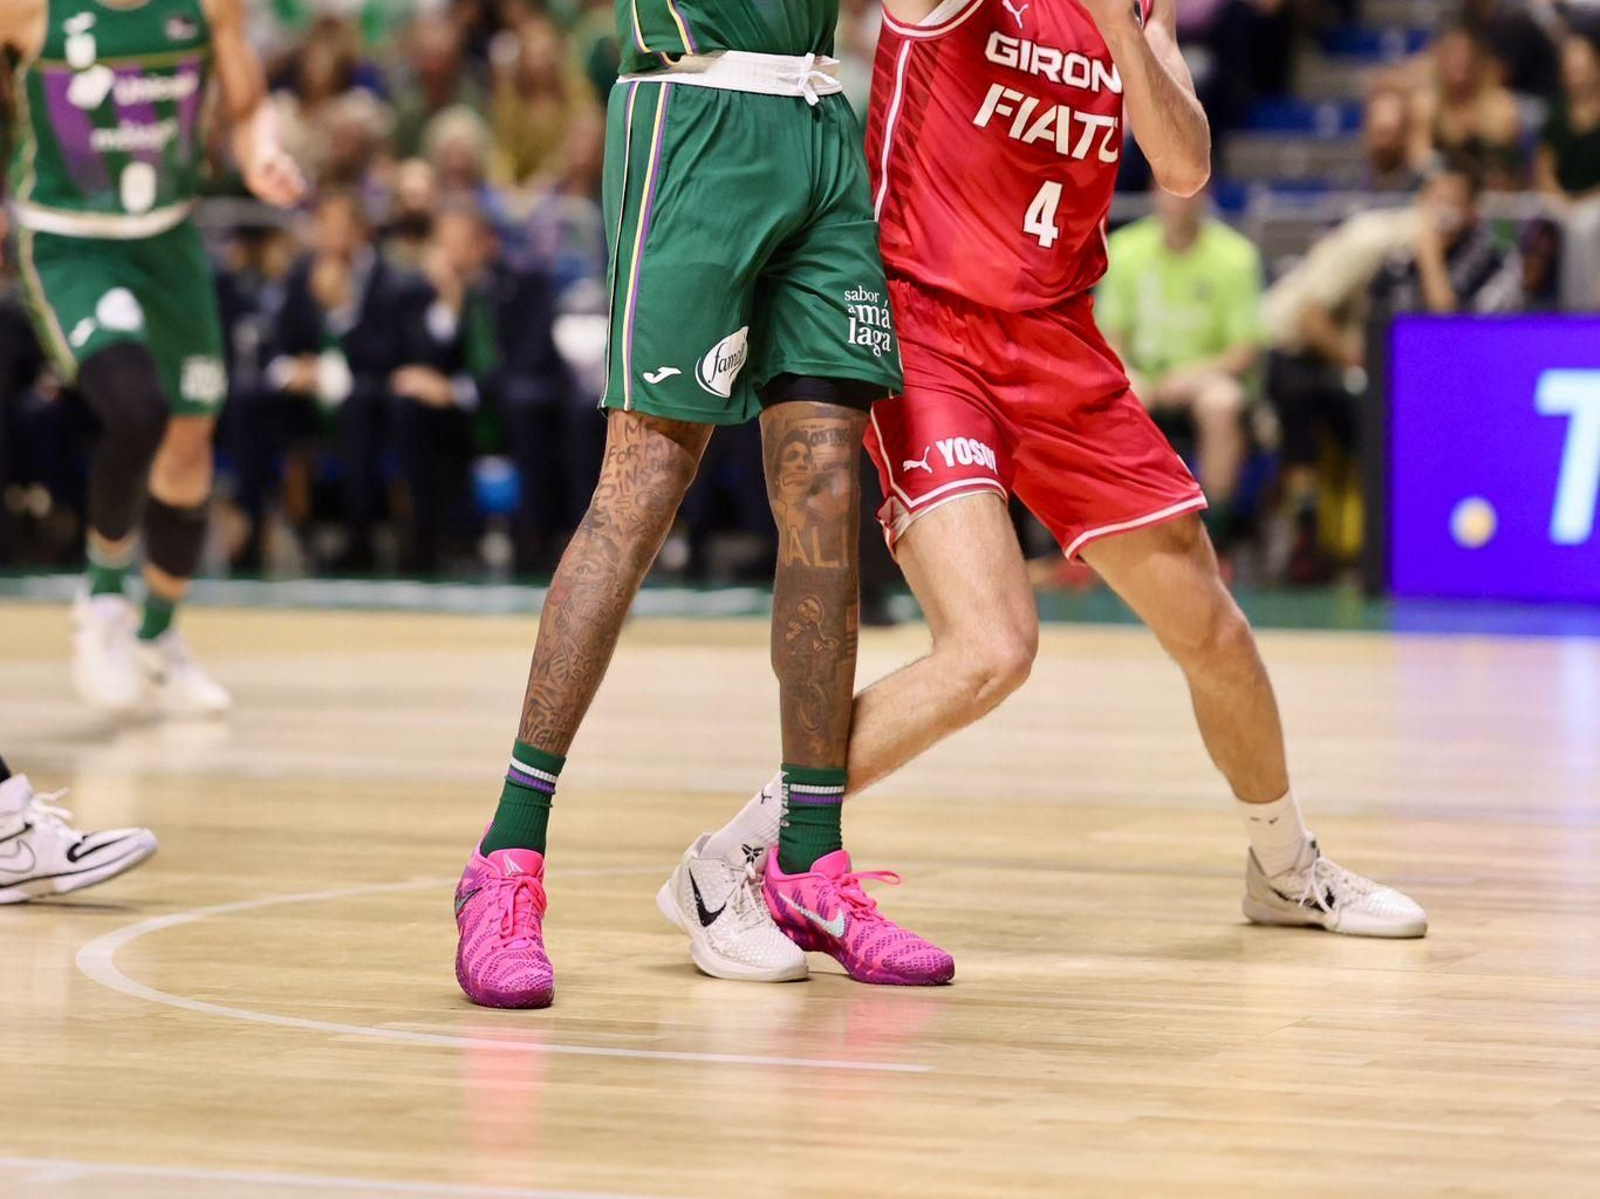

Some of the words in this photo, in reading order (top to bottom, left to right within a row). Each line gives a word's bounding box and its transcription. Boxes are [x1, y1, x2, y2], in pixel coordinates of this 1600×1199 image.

[1023, 180, 1063, 248] 4
[844, 285, 880, 302] sabor
[847, 316, 892, 358] laga
